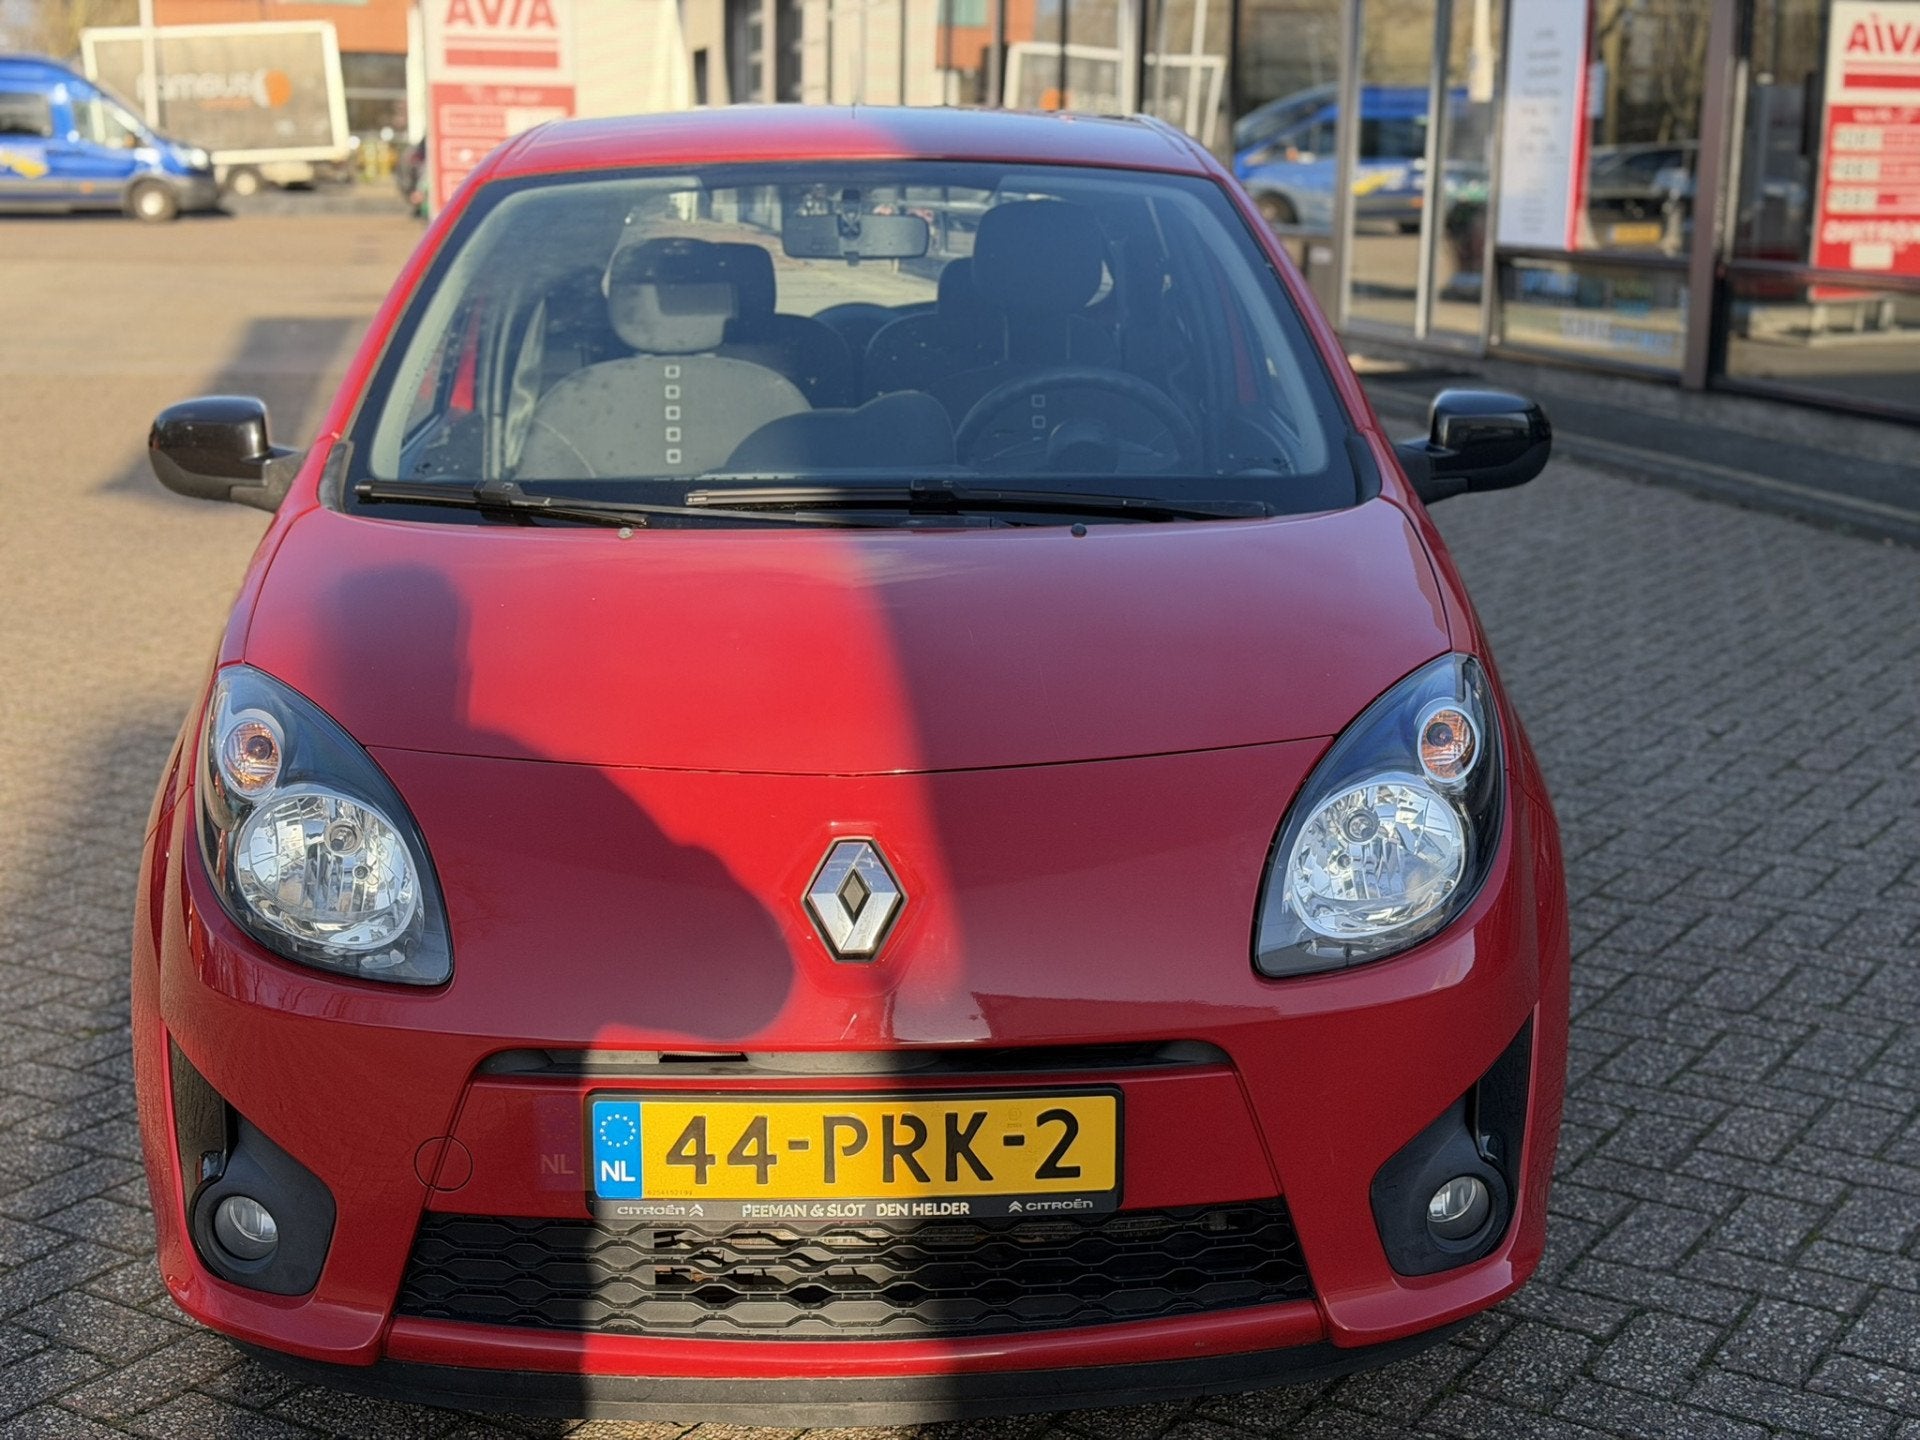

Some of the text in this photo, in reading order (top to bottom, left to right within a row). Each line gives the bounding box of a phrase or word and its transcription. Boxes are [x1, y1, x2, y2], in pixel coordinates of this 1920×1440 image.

[446, 0, 558, 27] AVIA
[666, 1108, 1081, 1185] 44-PRK-2
[600, 1160, 637, 1182] NL
[742, 1202, 971, 1218] PEEMAN & SLOT DEN HELDER
